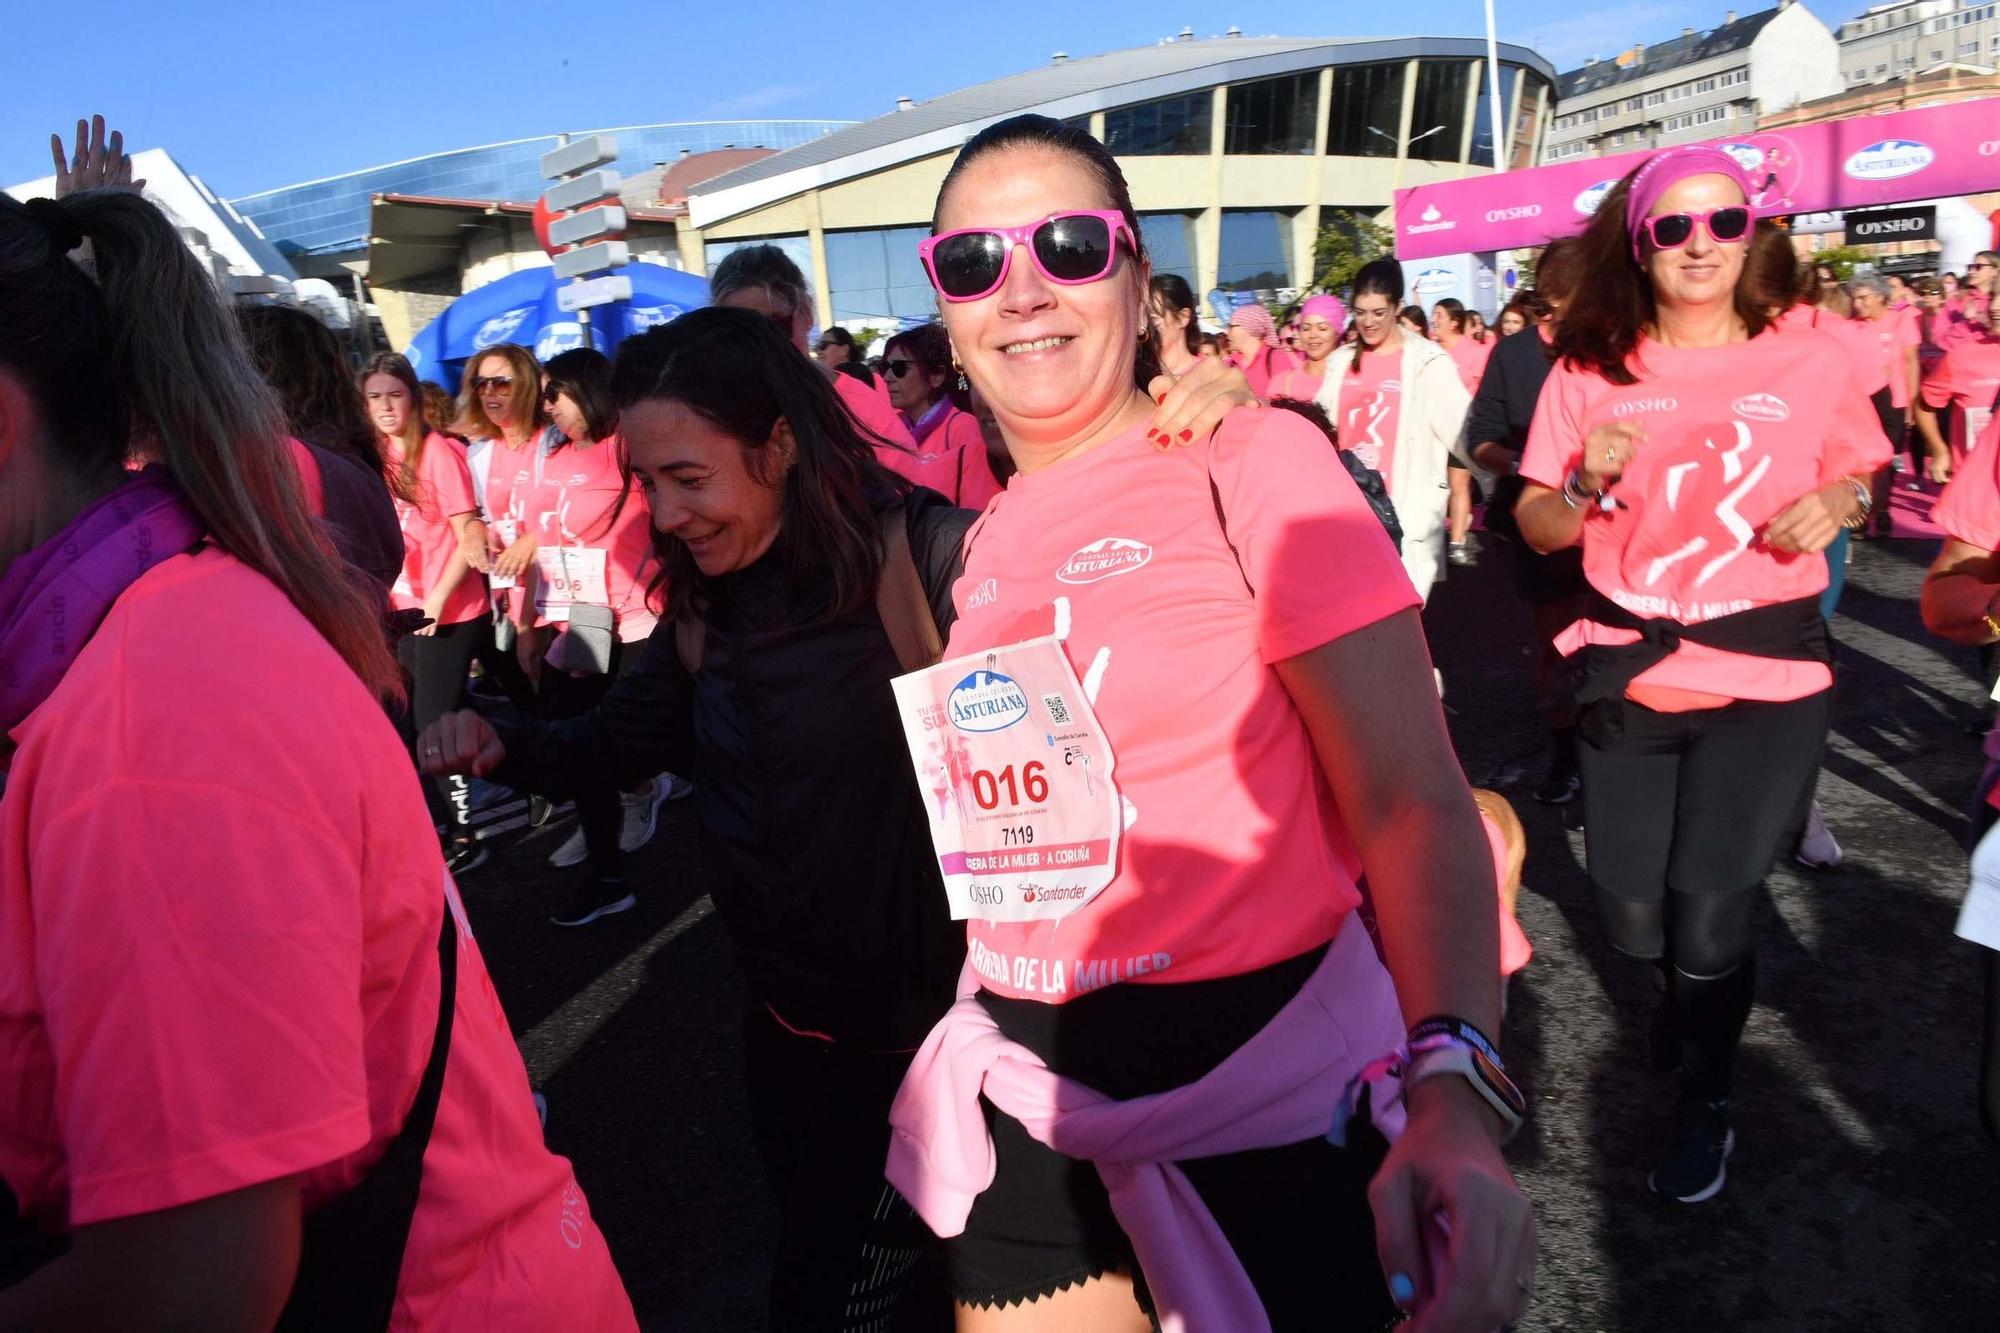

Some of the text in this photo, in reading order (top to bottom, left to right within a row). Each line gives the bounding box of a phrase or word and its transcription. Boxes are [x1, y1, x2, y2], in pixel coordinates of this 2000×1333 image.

[1485, 203, 1542, 223] OYSHO
[1855, 217, 1926, 235] OYSHO
[1612, 397, 1679, 417] OYSHO
[1060, 550, 1143, 577] ASTURIANA
[555, 578, 582, 592] 06
[954, 694, 1026, 722] ASTURIANA
[972, 760, 1049, 810] 016
[1002, 825, 1034, 846] 7119
[988, 858, 998, 869] DE
[999, 856, 1010, 869] LA
[1012, 852, 1040, 868] MUJER
[1047, 852, 1052, 865] A
[1055, 845, 1090, 864] CORUÑA
[1037, 885, 1087, 902] Santander
[1013, 956, 1039, 992] DE
[1041, 959, 1067, 993] LA
